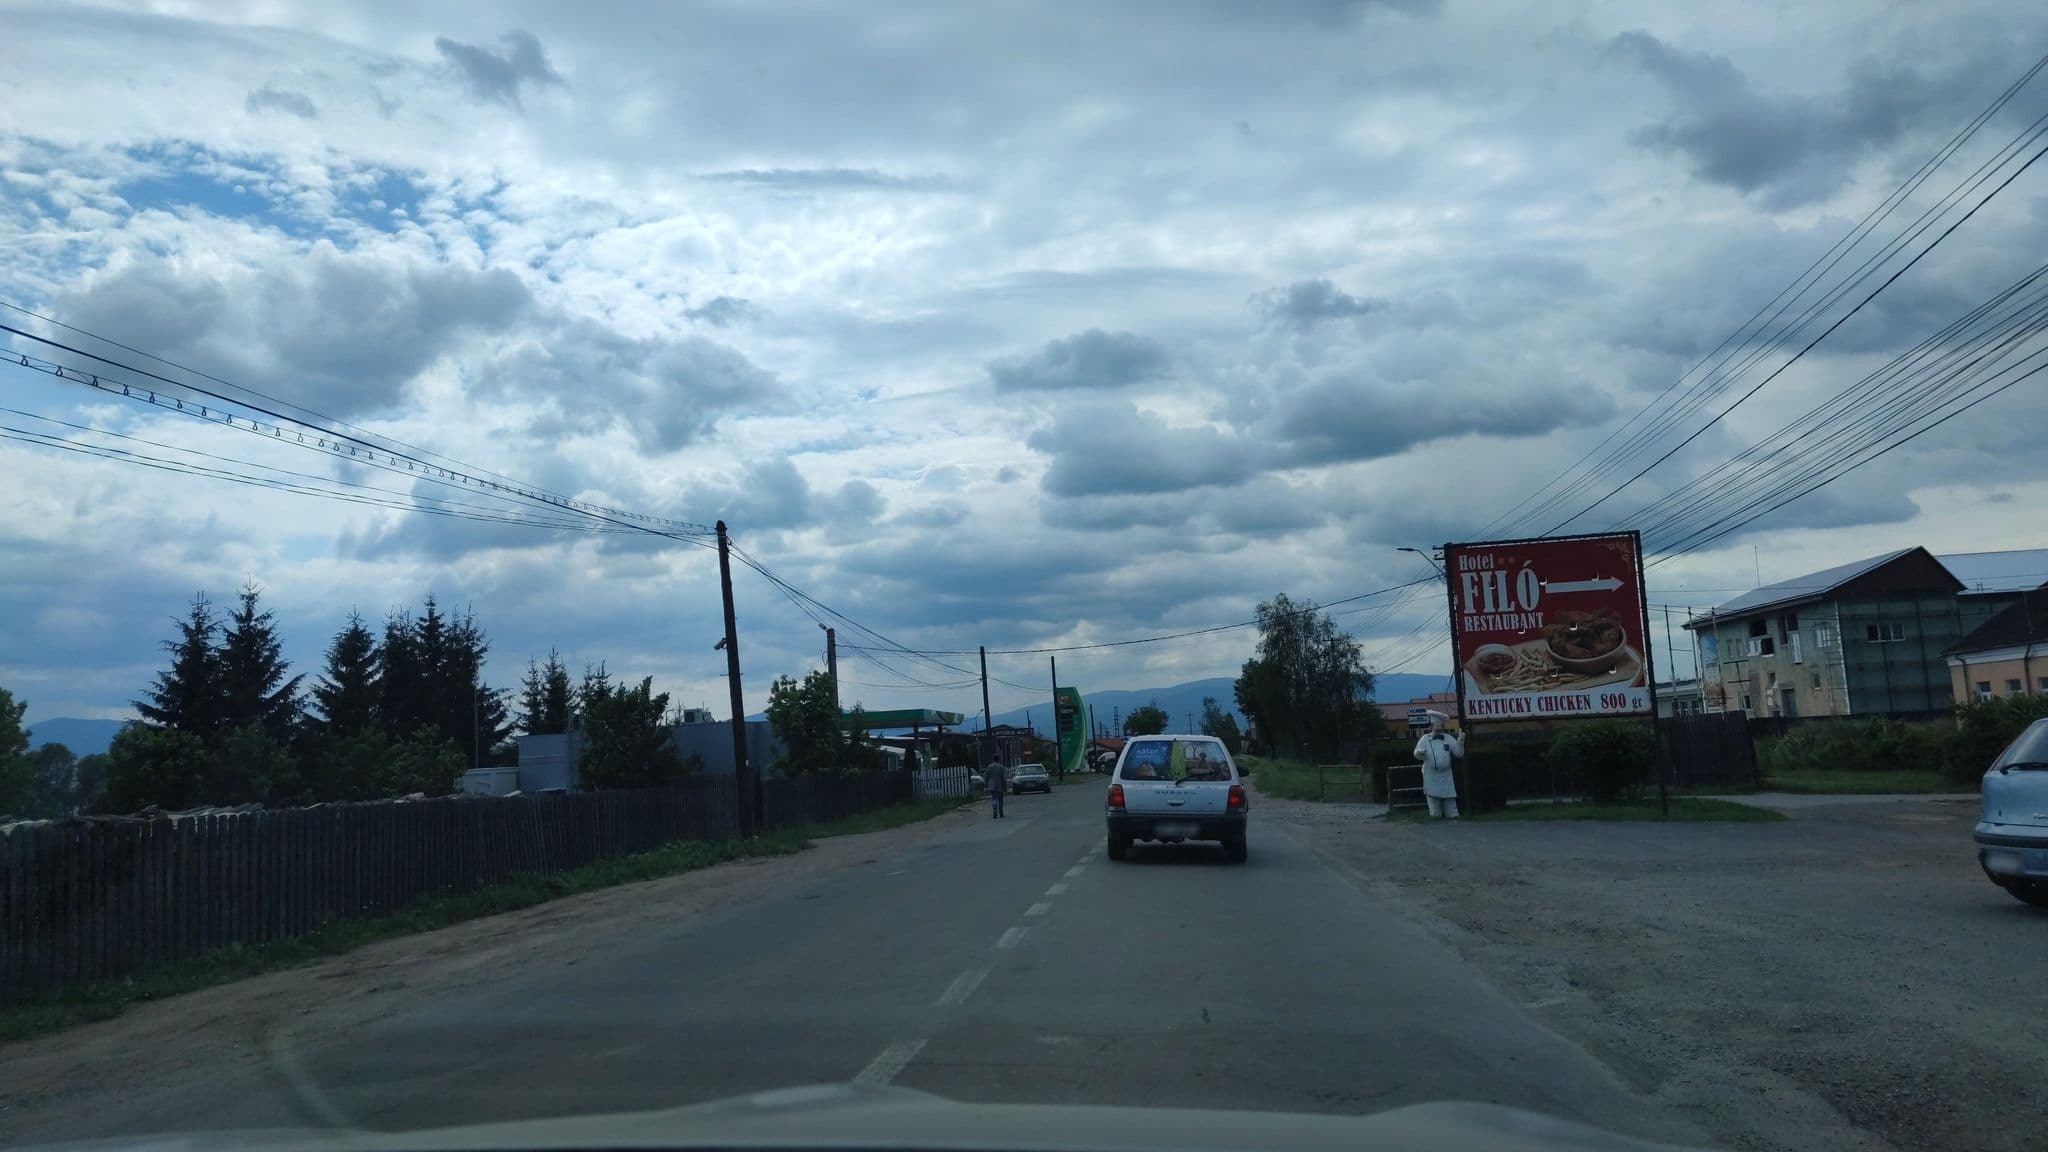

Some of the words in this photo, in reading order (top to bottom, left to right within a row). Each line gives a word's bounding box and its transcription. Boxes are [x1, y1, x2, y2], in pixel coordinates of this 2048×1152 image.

[1459, 553, 1494, 570] Hotel
[1460, 560, 1540, 613] FILÓ
[1464, 612, 1544, 632] RESTAURANT
[1469, 697, 1532, 715] KENTUCKY
[1538, 694, 1591, 712] CHICKEN
[1600, 693, 1626, 709] 800
[1632, 697, 1642, 709] gr
